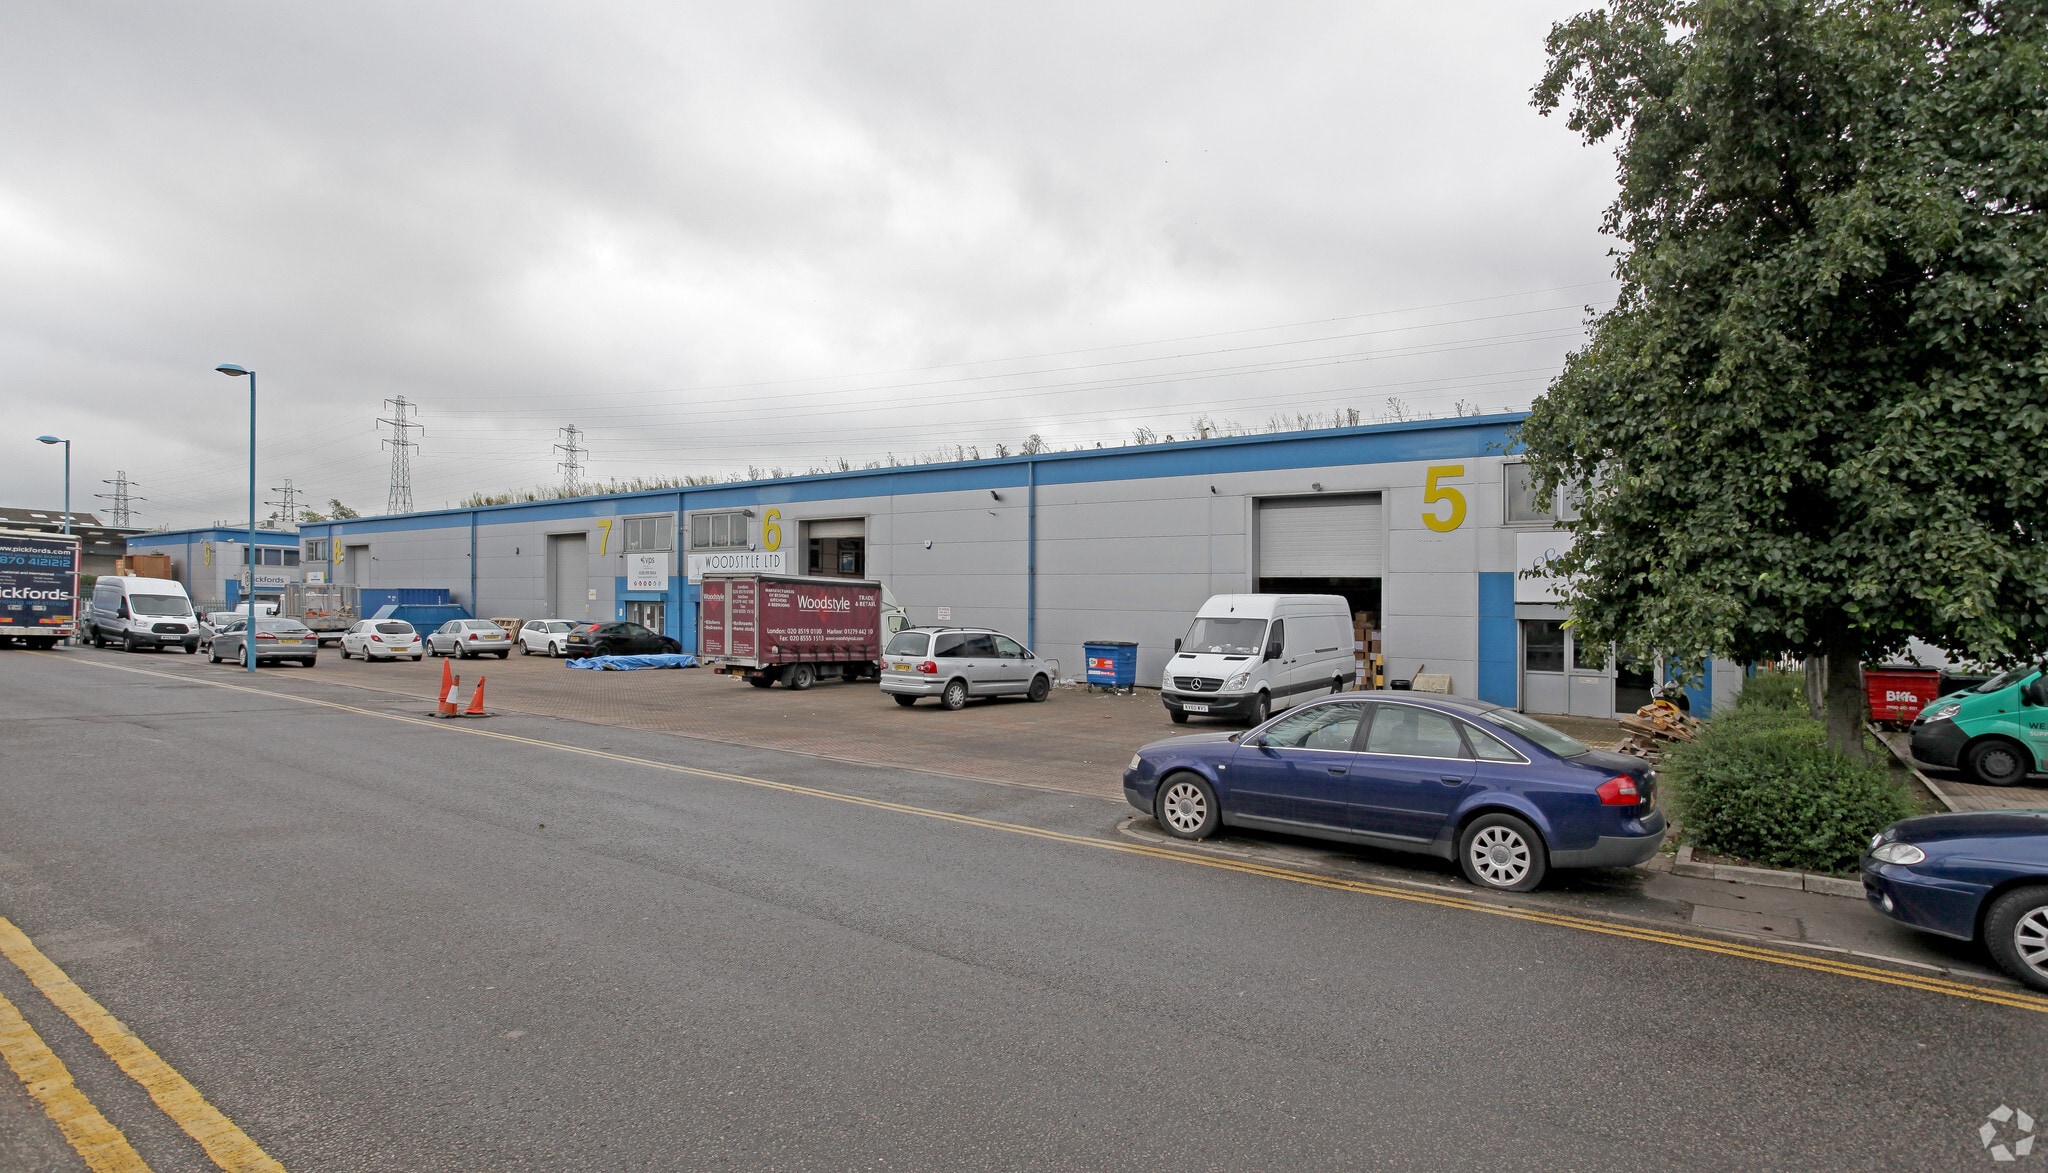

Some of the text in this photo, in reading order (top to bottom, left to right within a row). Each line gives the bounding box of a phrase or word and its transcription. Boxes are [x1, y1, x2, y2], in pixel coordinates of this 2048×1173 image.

[1422, 465, 1467, 533] 5
[597, 519, 612, 556] 7
[763, 508, 782, 552] 6
[0, 546, 71, 556] ww.pickfords.com
[204, 543, 211, 566] 9
[334, 539, 342, 565] 8
[0, 556, 71, 568] 870 4121212
[705, 554, 780, 569] WOODSTYLE LTD
[0, 586, 69, 601] ickfords
[797, 595, 850, 612] Woodstyle
[1886, 691, 1917, 702] Biffa
[2029, 722, 2046, 730] WE
